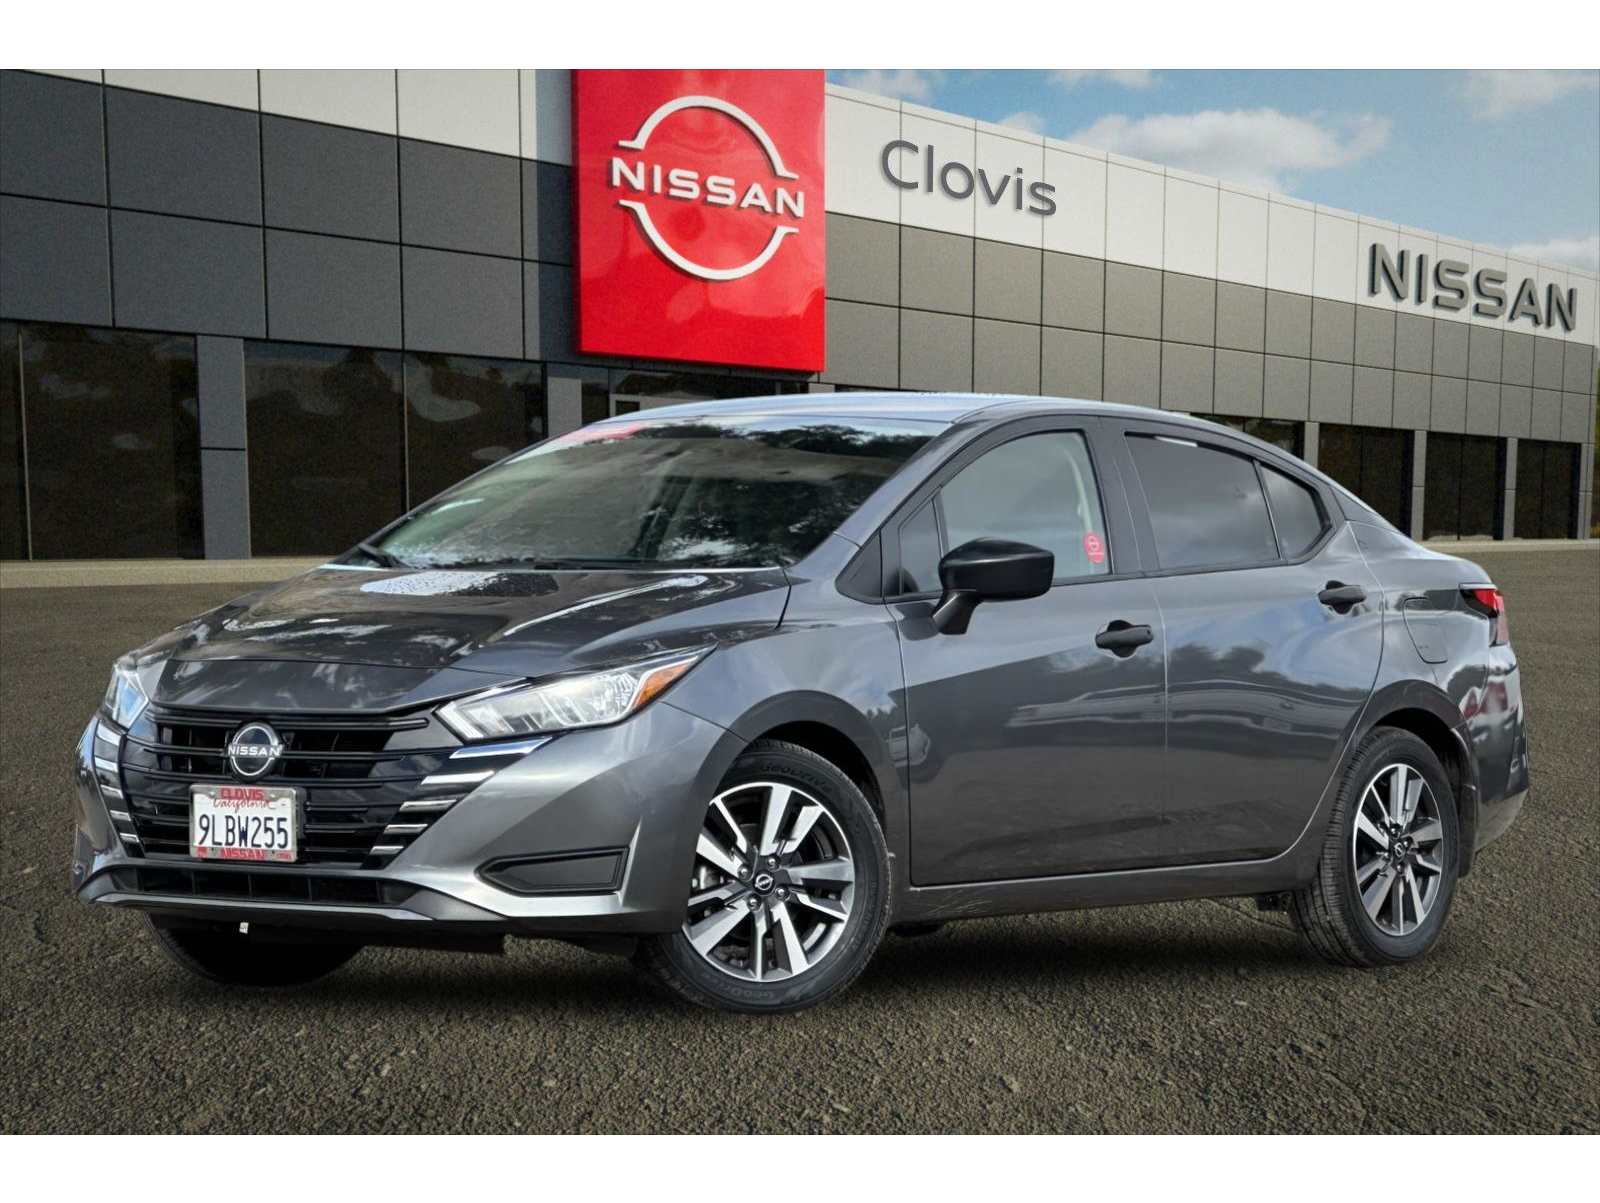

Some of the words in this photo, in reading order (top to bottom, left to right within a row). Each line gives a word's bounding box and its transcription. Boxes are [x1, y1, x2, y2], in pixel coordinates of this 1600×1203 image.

[609, 156, 805, 218] NISSAN
[881, 139, 1057, 216] Clovis
[1368, 242, 1578, 332] NISSAN
[227, 743, 284, 757] NISSAN
[197, 813, 289, 849] 9LBW255
